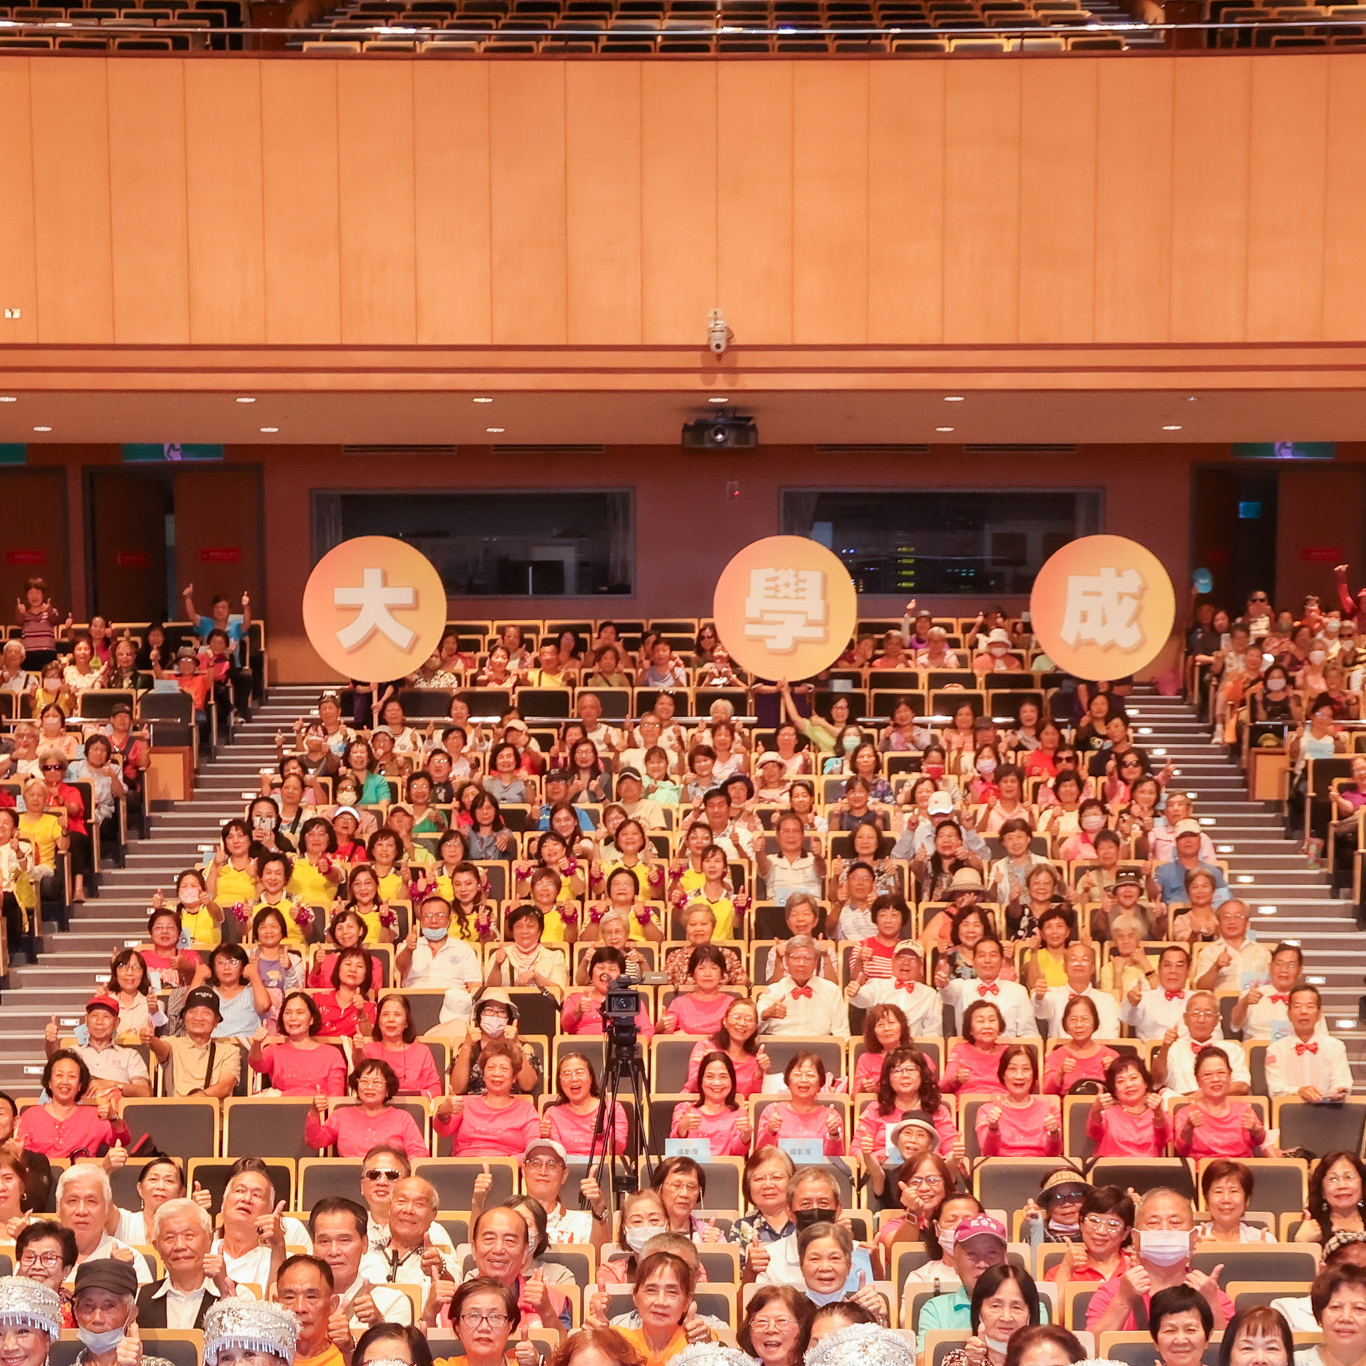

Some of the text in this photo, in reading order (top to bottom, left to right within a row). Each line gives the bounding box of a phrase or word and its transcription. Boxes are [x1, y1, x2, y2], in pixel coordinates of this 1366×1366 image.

[334, 568, 416, 651] 大
[745, 567, 826, 651] 學
[1060, 566, 1144, 649] 成
